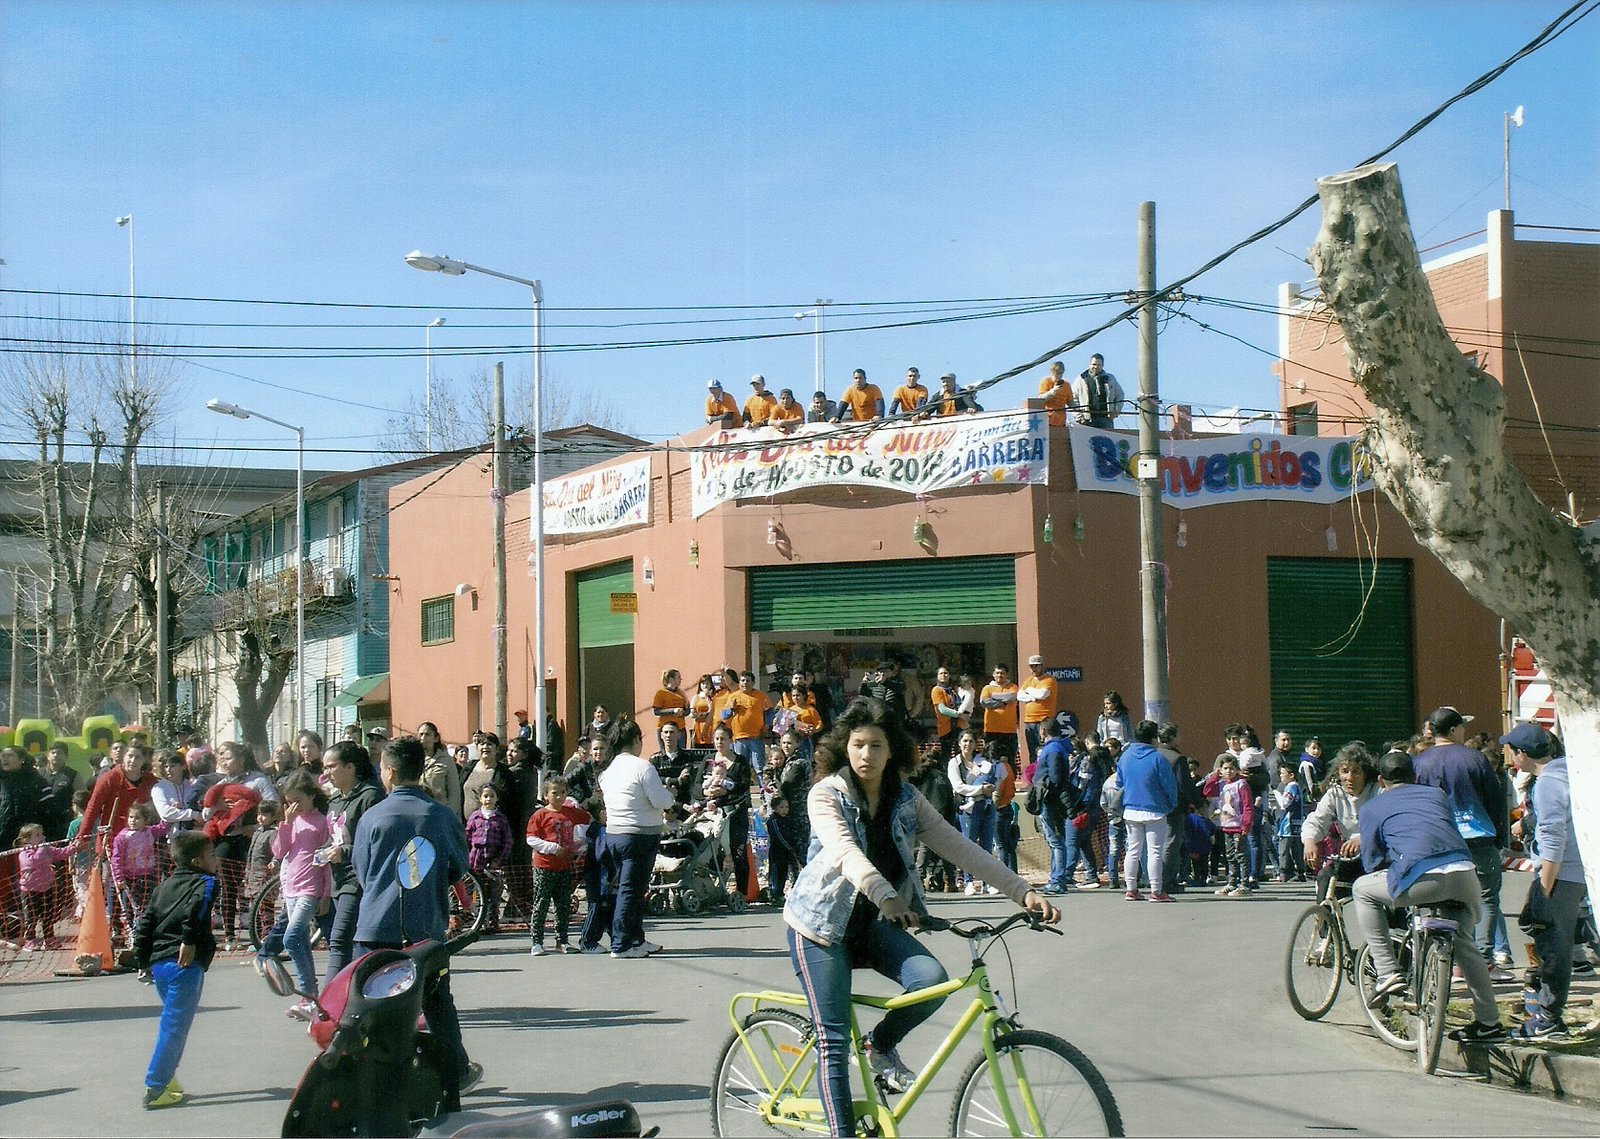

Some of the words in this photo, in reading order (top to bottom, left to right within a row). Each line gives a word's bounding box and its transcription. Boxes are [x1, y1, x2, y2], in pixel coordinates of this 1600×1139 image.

[734, 467, 755, 491] de
[862, 460, 882, 478] de
[571, 1109, 627, 1128] Keller
